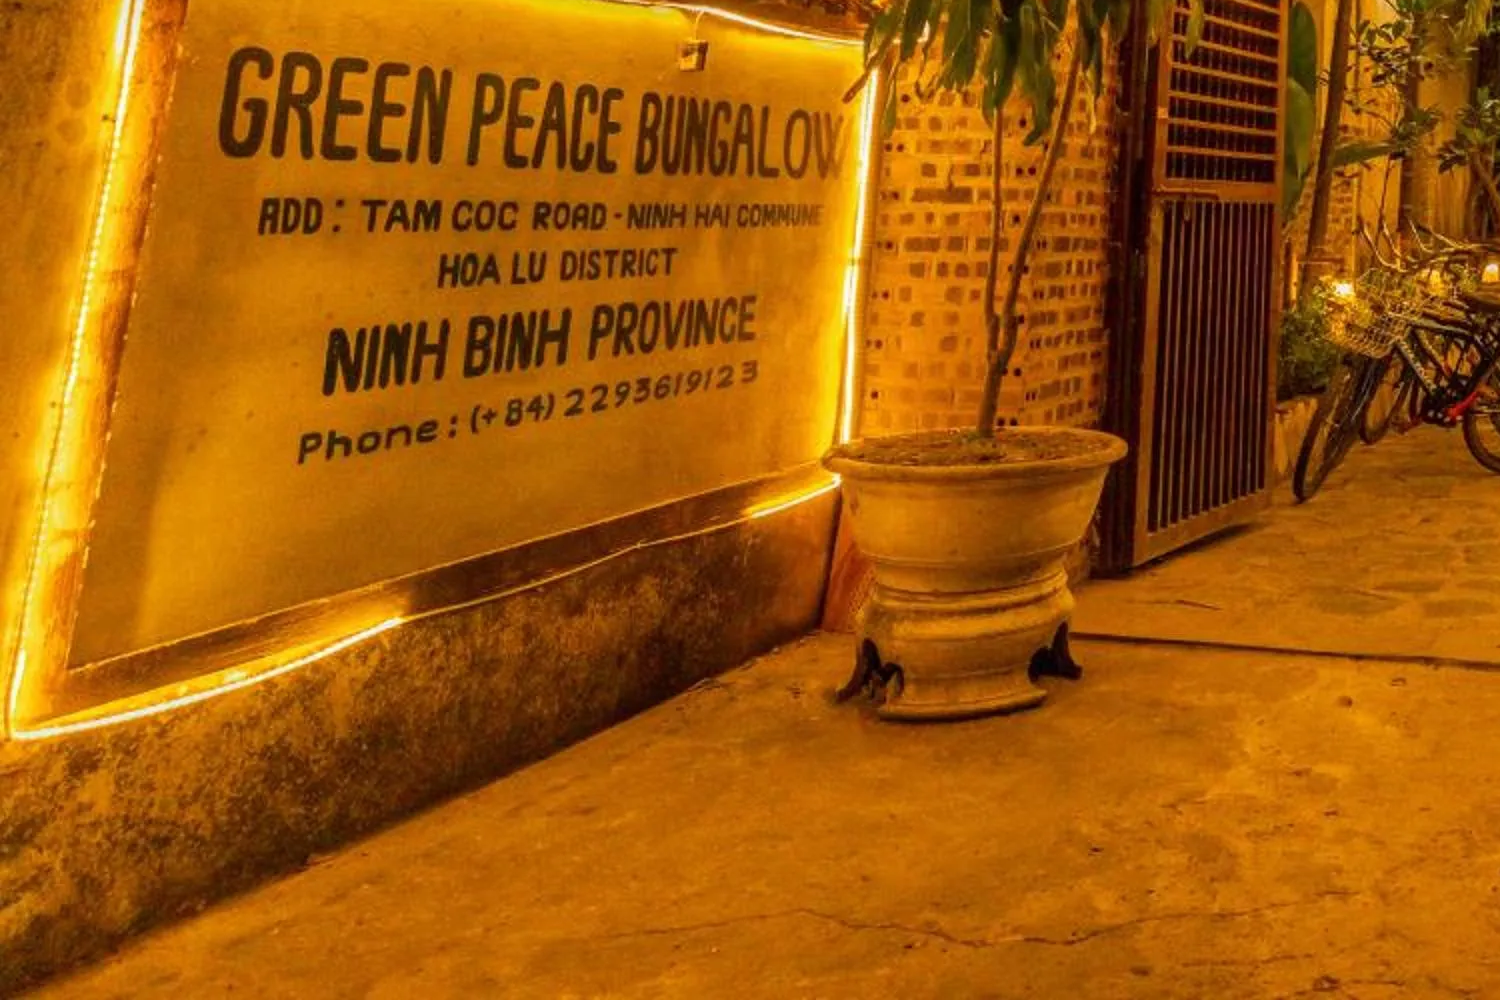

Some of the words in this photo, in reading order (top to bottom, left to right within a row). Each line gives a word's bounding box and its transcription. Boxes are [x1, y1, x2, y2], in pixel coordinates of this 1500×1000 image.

[218, 46, 453, 163] GREEN
[466, 73, 625, 174] PEACE
[635, 91, 844, 180] BUNGALOW
[361, 199, 442, 232] TAM
[451, 200, 519, 232] COC
[531, 202, 607, 231] ROAD
[627, 203, 688, 229] NINH
[694, 203, 730, 228] HAI
[735, 203, 825, 228] COMMUNE
[437, 252, 501, 288] HOA
[510, 250, 548, 285] LU
[559, 247, 678, 282] DISTRICT
[321, 317, 450, 396] NINH
[463, 306, 572, 379] BINH
[587, 295, 757, 361] PROVINCE
[563, 359, 759, 417] 2293619123
